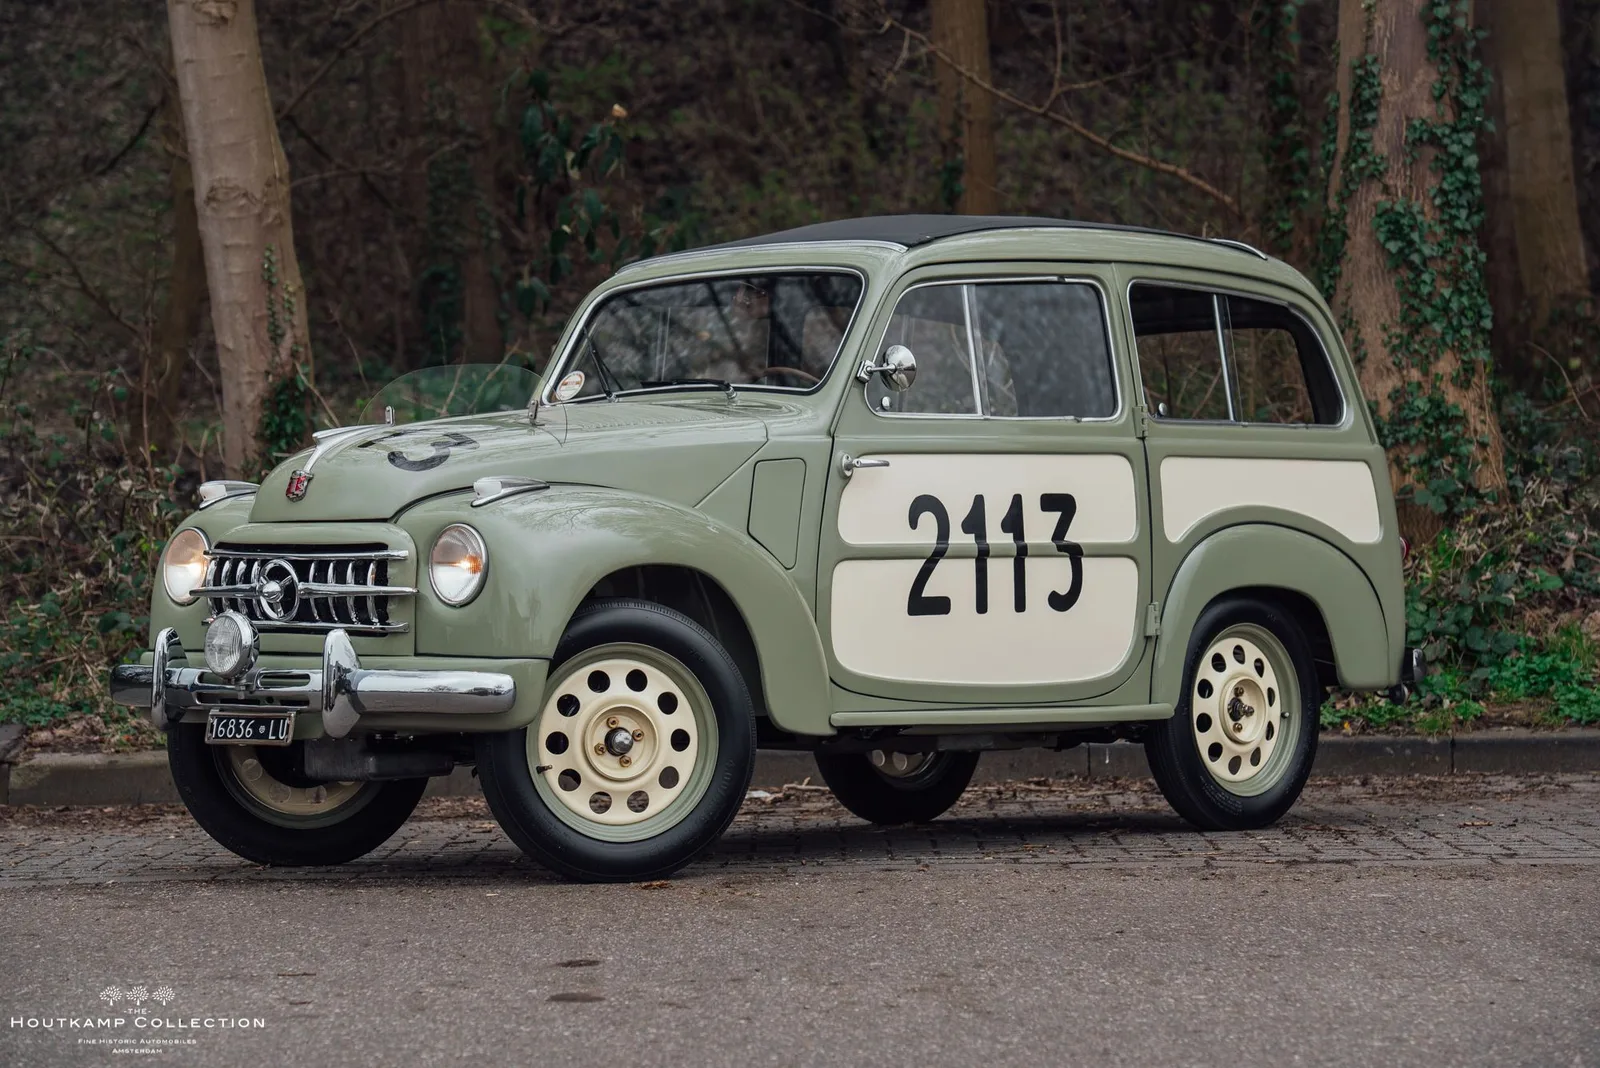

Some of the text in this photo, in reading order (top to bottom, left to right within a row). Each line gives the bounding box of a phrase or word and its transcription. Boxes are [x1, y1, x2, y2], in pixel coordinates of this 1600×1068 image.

[907, 492, 1084, 616] 2113
[212, 718, 288, 740] 16836 LU
